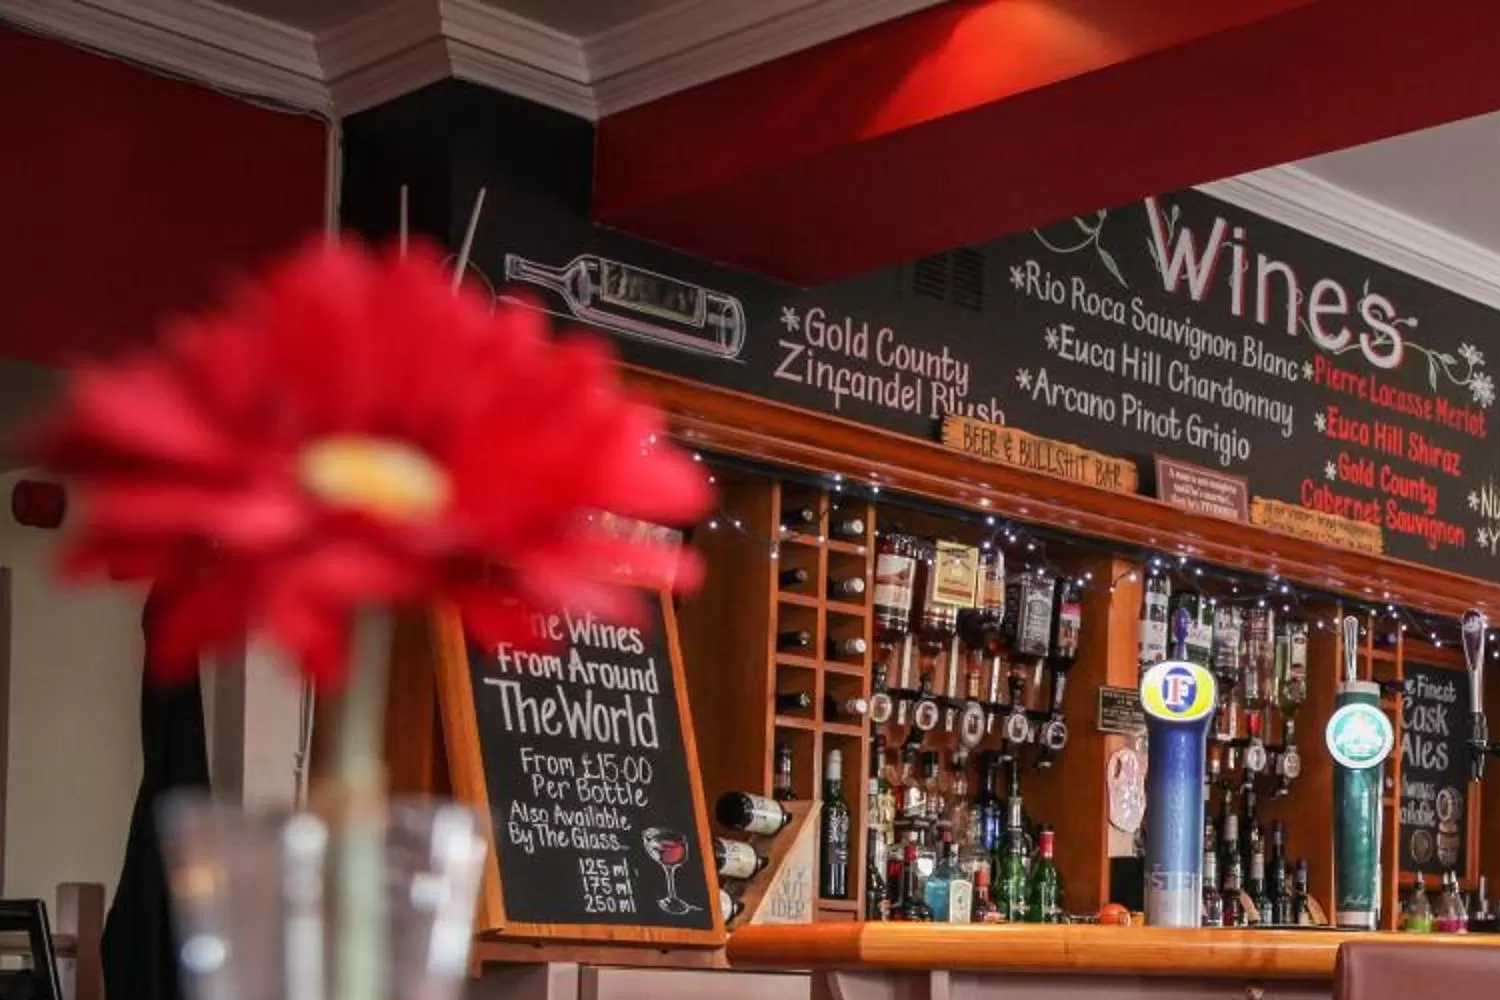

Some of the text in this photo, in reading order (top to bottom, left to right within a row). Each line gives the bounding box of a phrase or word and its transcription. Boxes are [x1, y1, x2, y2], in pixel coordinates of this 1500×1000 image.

[1144, 196, 1404, 369] Wines
[1071, 276, 1126, 325] Roca
[1131, 296, 1237, 360] Sauvignon
[1242, 335, 1299, 382] Blanc
[773, 339, 922, 414] Zinfandel
[875, 327, 969, 397] County
[1121, 341, 1161, 387] Hill
[1168, 359, 1293, 438] Chardonnay
[1121, 392, 1181, 440] Pinot
[1186, 412, 1250, 466] Grigio
[1435, 396, 1487, 439] Merlot
[963, 423, 997, 457] BEER
[1019, 438, 1090, 481] BULLSHIT
[1095, 459, 1123, 488] BAR
[1374, 420, 1404, 457] Hill
[1407, 431, 1462, 477] Shiraz
[1380, 464, 1438, 515] County
[1301, 479, 1381, 524] Cabernet
[1385, 498, 1465, 550] Sauvignon
[563, 606, 645, 655] Wines
[497, 640, 660, 695] From Around
[1166, 675, 1195, 706] F
[1416, 673, 1456, 703] Finest
[483, 677, 659, 749] The World
[1402, 695, 1449, 736] Cask
[520, 747, 575, 778] From
[1402, 732, 1448, 771] Ales
[531, 773, 649, 807] Per Bottle
[508, 821, 535, 854] By
[532, 823, 569, 848] The
[510, 799, 632, 831] Also Available
[578, 857, 629, 877] 125 ml
[582, 876, 634, 896] 175 ml
[584, 894, 637, 913] 250 ml
